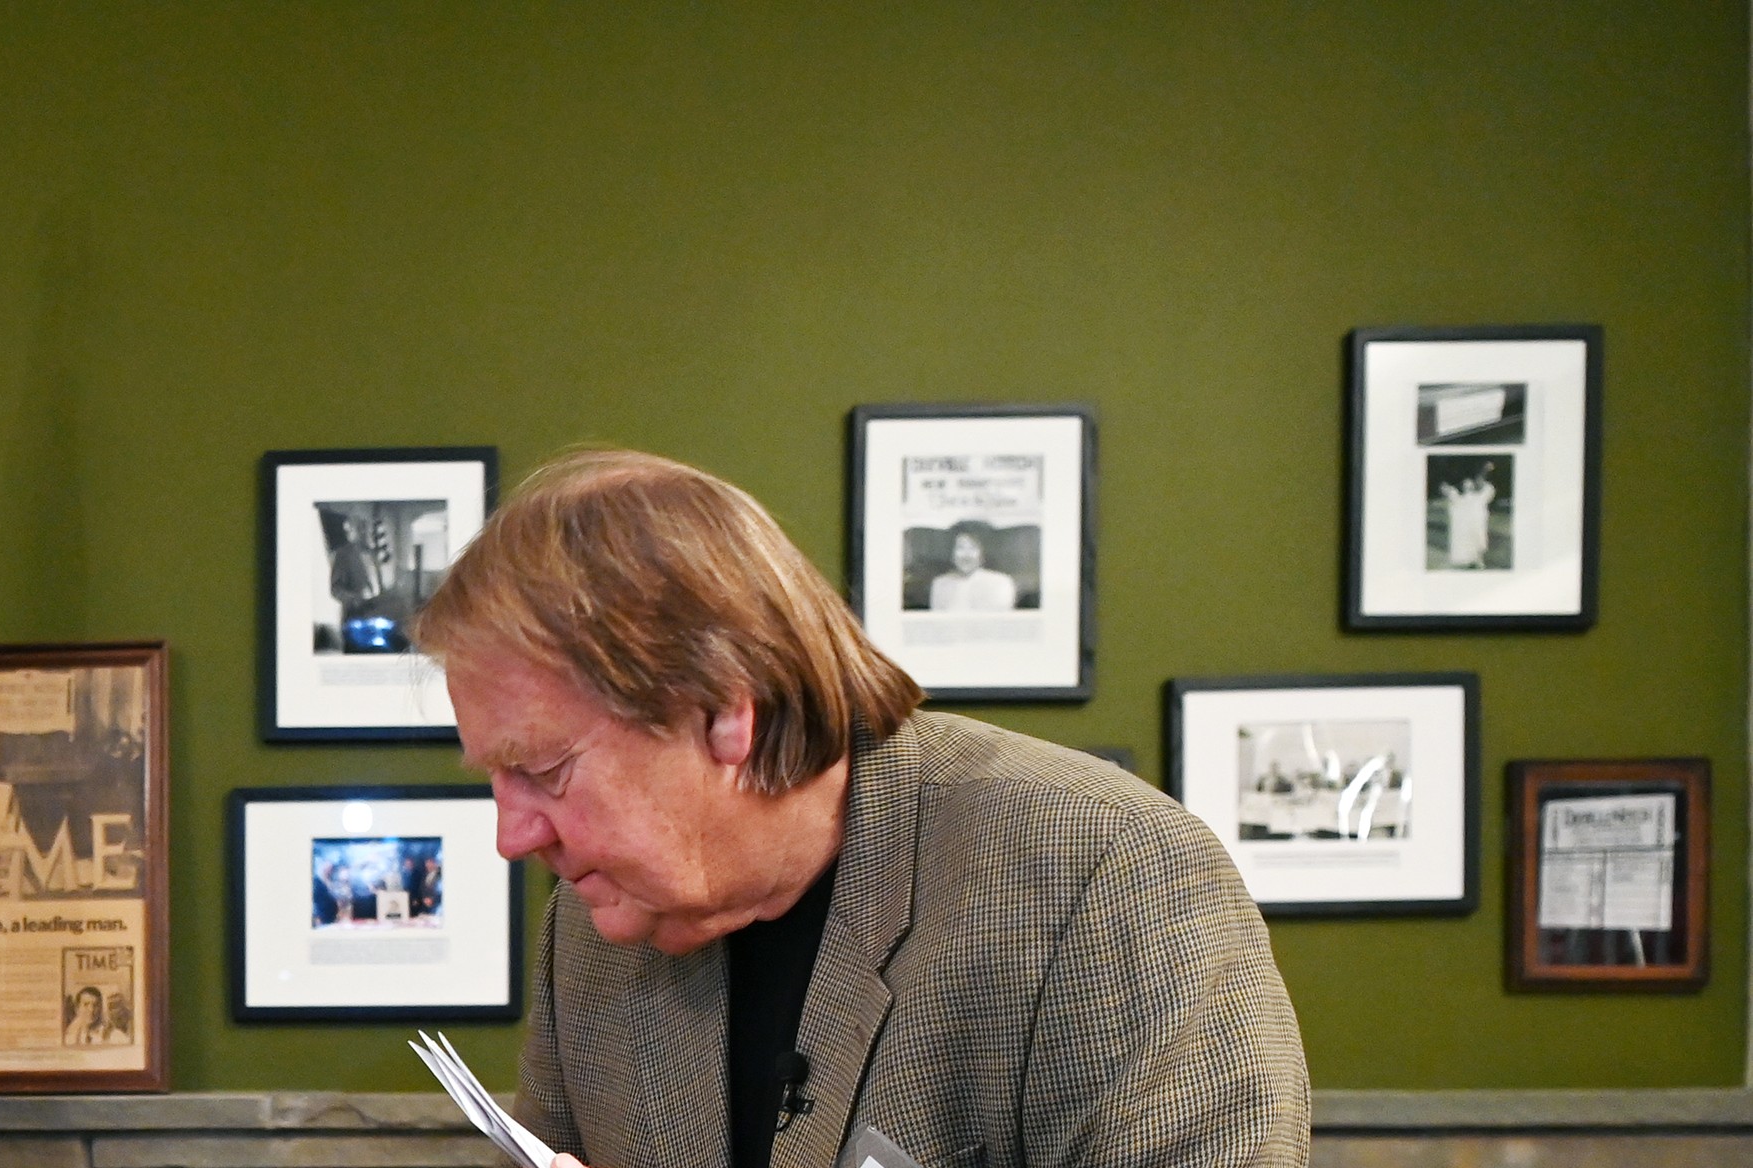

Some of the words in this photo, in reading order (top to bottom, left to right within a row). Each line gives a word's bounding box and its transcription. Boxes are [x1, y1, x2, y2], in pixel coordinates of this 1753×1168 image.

[11, 919, 21, 933] a
[23, 912, 84, 935] leading
[86, 918, 128, 932] man.
[75, 953, 118, 971] TIME
